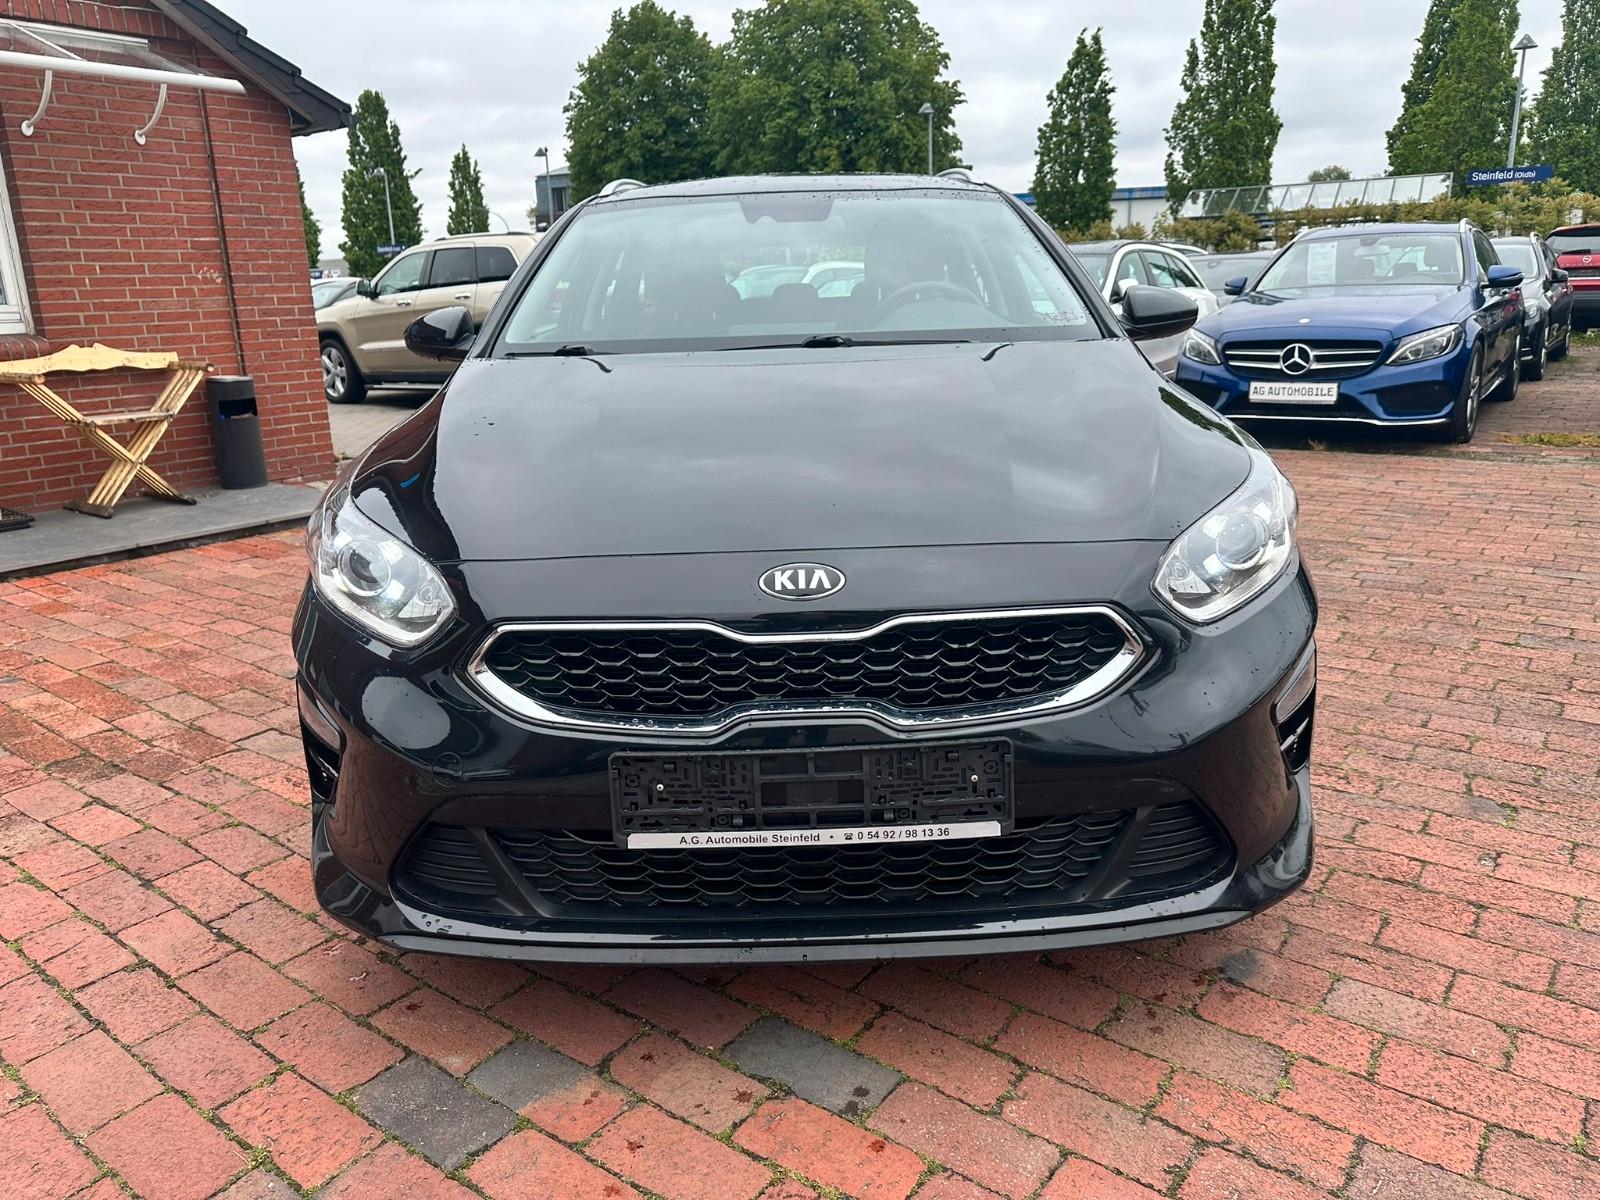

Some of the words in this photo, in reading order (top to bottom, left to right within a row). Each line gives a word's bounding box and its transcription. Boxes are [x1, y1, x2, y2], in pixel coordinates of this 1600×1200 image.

[1472, 170, 1514, 181] Steinfeld
[1515, 170, 1536, 178] (Oldb)
[1252, 386, 1266, 396] AG
[1267, 387, 1334, 397] AUTOMOBILE
[773, 568, 832, 591] KIA
[679, 836, 703, 845] A.G.
[706, 834, 769, 845] Automobile
[771, 833, 820, 843] Steinfeld
[857, 831, 864, 840] 0
[867, 831, 880, 840] 54
[883, 830, 896, 839] 92
[905, 829, 918, 838] 98
[922, 828, 934, 837] 13
[937, 827, 950, 836] 36
